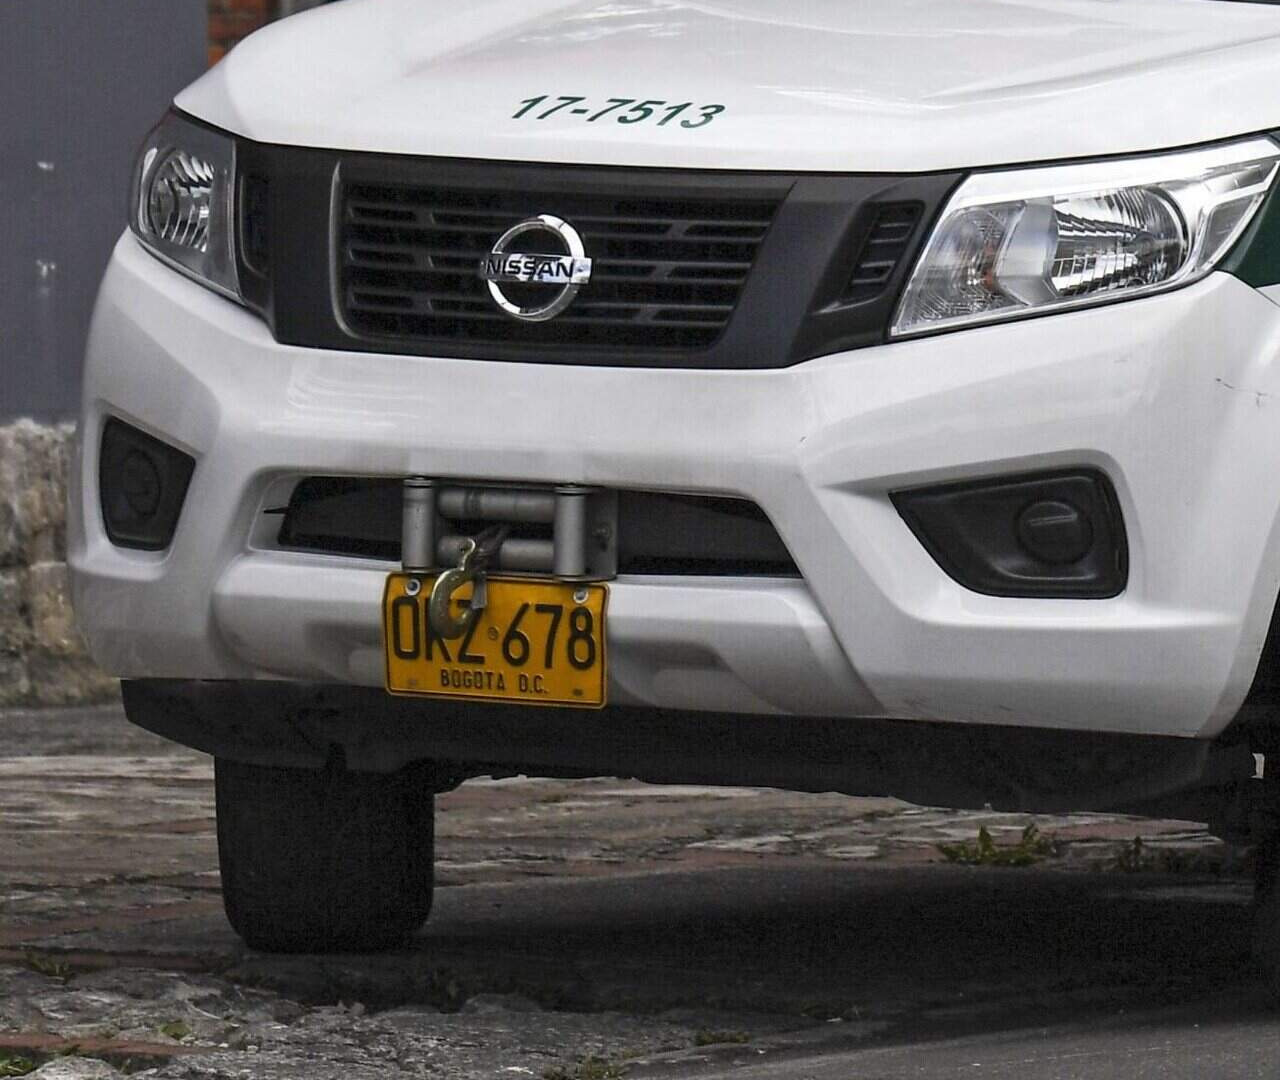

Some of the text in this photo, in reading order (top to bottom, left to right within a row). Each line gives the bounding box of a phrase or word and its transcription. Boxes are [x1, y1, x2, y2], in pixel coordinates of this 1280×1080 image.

[511, 95, 726, 128] 17-7513
[486, 258, 574, 278] NISSAN
[502, 602, 596, 671] 678
[440, 669, 548, 694] BOGOTA D.C.
